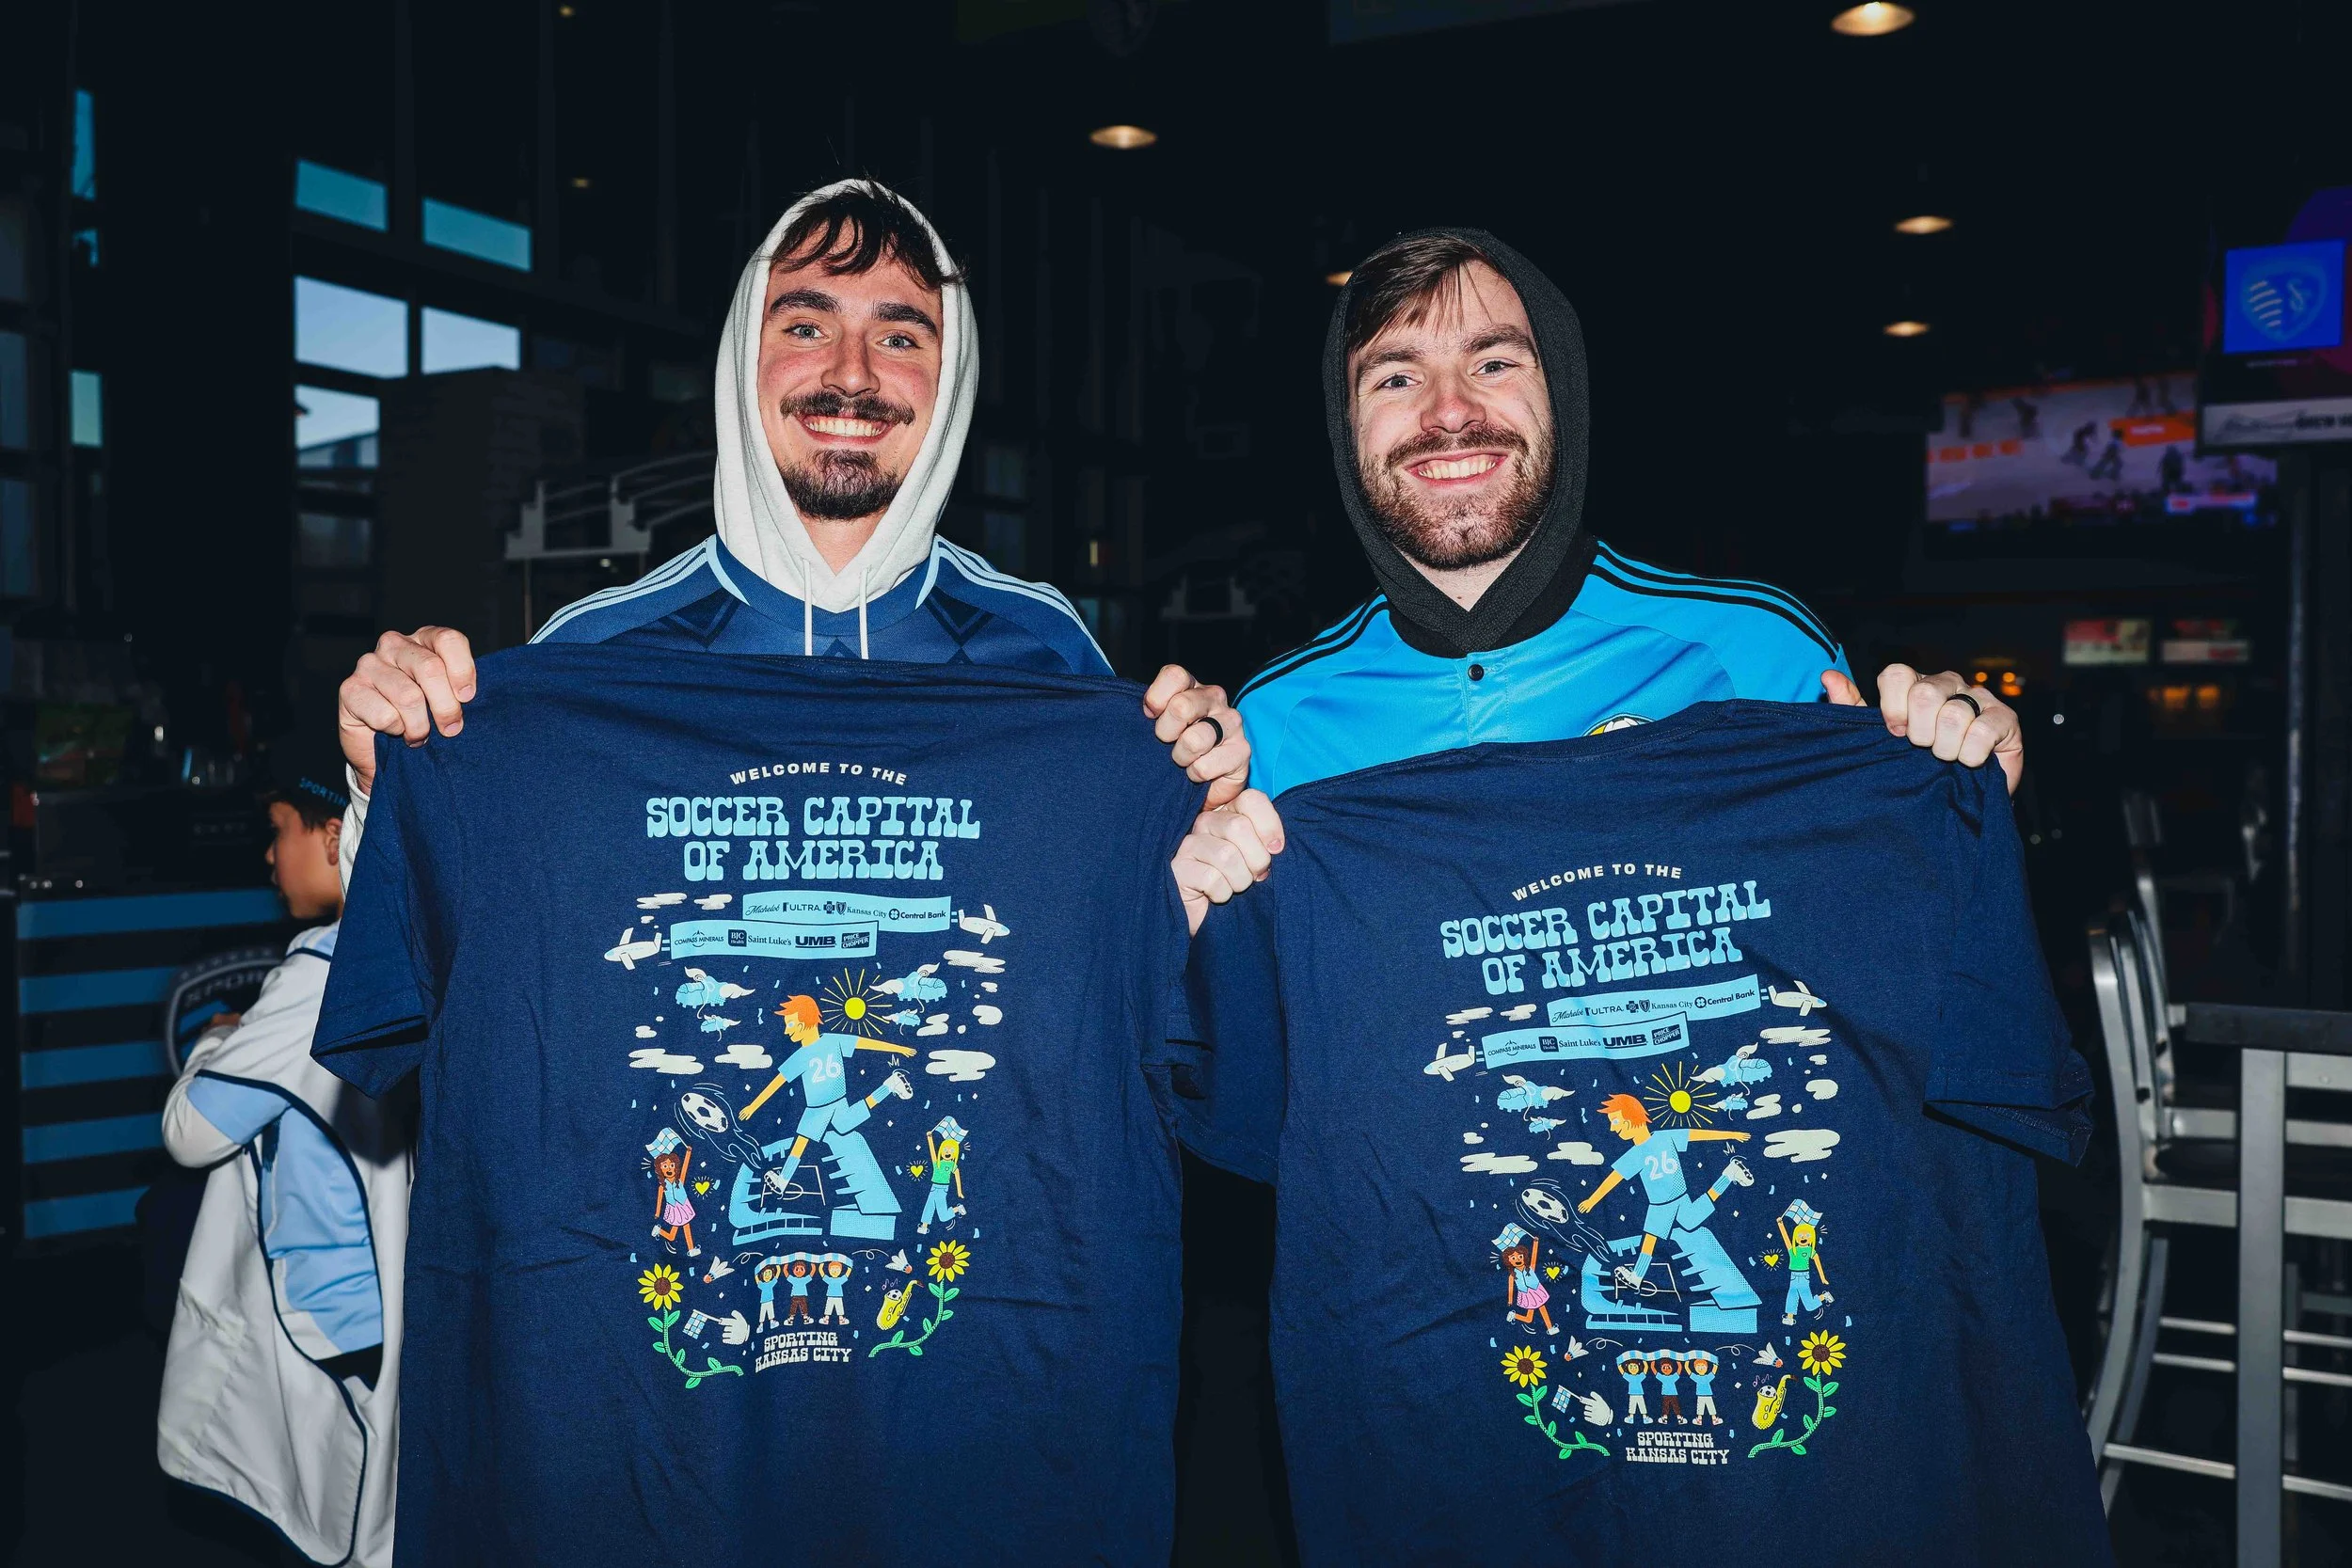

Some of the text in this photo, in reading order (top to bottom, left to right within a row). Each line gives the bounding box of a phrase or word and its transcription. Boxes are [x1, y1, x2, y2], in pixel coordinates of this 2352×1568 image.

[730, 762, 908, 785] WELCOME TO THE
[299, 776, 349, 807] SPORTIN
[646, 797, 980, 839] SOCCER CAPITAL
[684, 840, 944, 881] OF AMERICA
[1512, 863, 1682, 902] WELCOME TO THE
[789, 903, 820, 911] ULTRA
[847, 906, 888, 919] Kansas City
[928, 911, 946, 919] Bank
[1439, 880, 1772, 959] SOCCER CAPITAL
[675, 937, 698, 945] COMPASS
[731, 931, 745, 940] BJC
[748, 935, 792, 945] Saint Luke's
[795, 935, 835, 946] UMB
[841, 937, 869, 948] CHOPPER
[843, 932, 860, 942] PRICE
[1482, 927, 1744, 996] OF AMERICA
[1678, 1000, 1693, 1009] City
[1708, 990, 1756, 1006] Central Bank
[1591, 1006, 1622, 1016] ULTRA
[1653, 1027, 1670, 1038] PRICE
[1653, 1030, 1681, 1045] CHOPPER
[1559, 1037, 1601, 1048] Saint Luke's
[1603, 1034, 1646, 1047] UMB
[1487, 1043, 1536, 1056] COMPASS MINERALS
[809, 1053, 842, 1084] 26
[1645, 1150, 1678, 1180] 26
[764, 1331, 838, 1353] SPORTING
[755, 1347, 852, 1373] KANSAS CITY
[1637, 1432, 1715, 1448] SPORTING
[1625, 1447, 1730, 1465] KANSAS CITY
